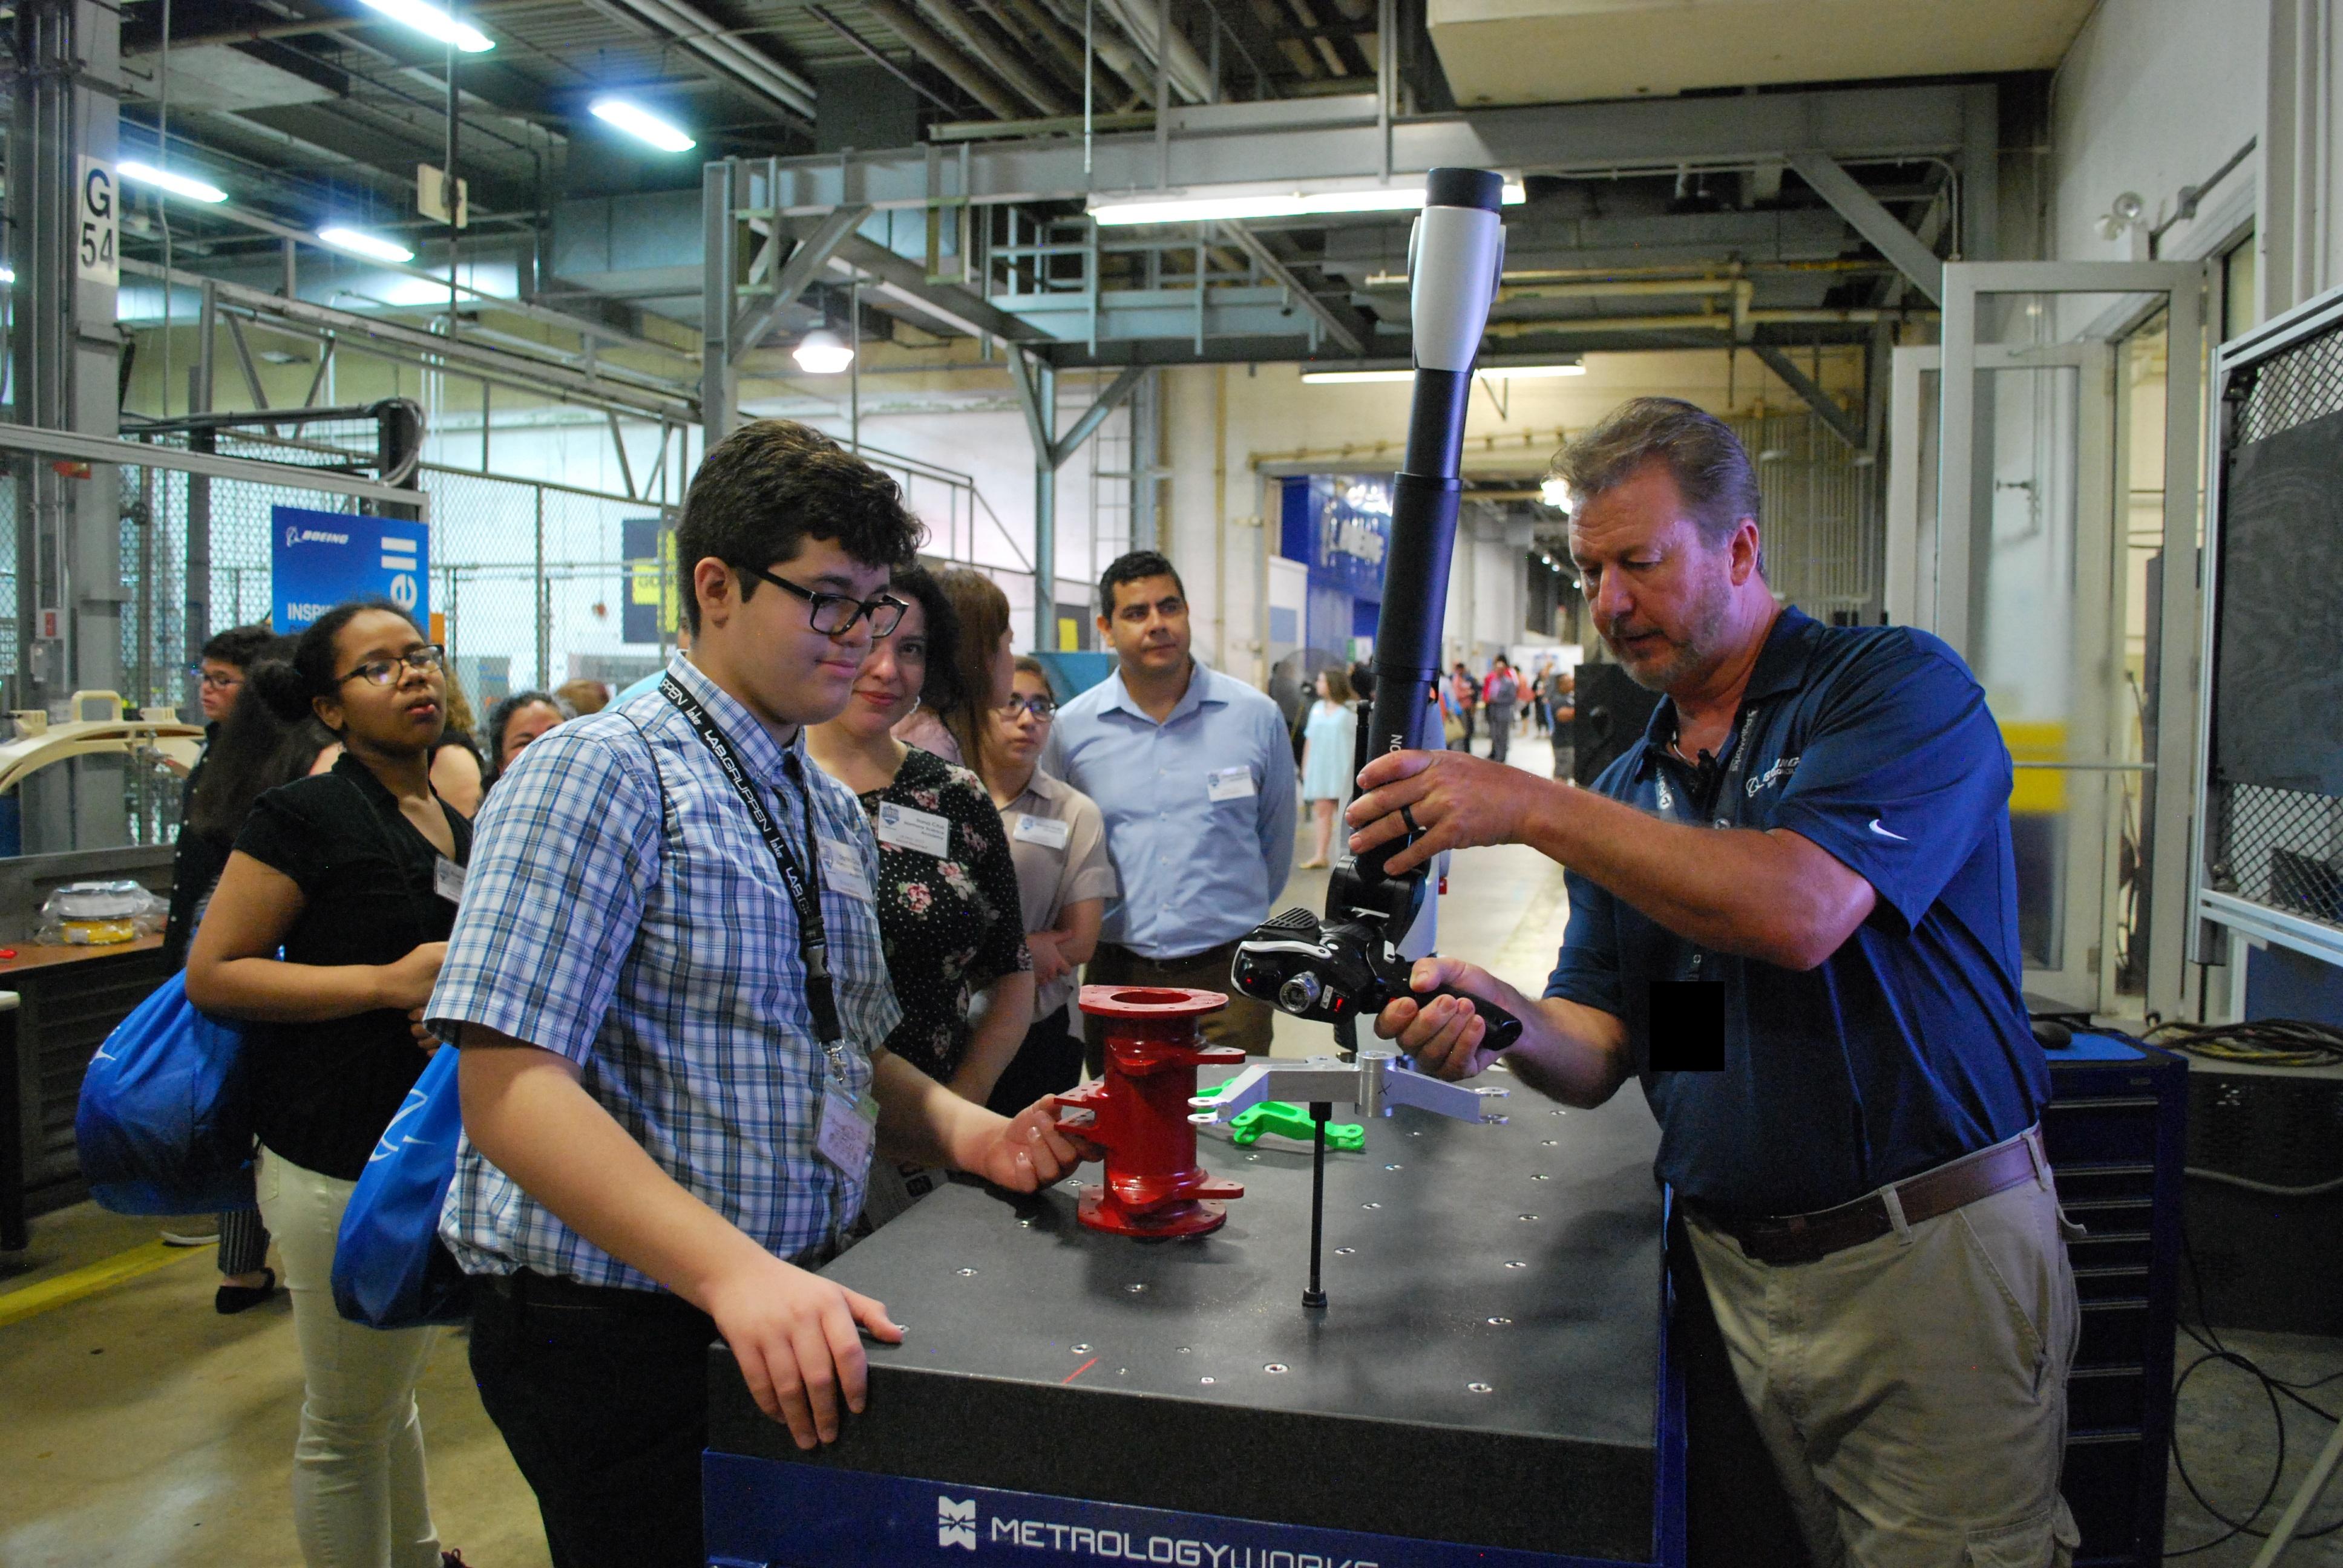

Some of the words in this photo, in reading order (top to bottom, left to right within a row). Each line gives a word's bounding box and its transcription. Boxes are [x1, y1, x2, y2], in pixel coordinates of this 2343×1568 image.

[86, 168, 111, 220] G
[81, 221, 114, 270] 54
[302, 530, 349, 544] BOEING
[287, 602, 333, 621] INSP
[703, 729, 772, 833] LAB.GRUPPEN
